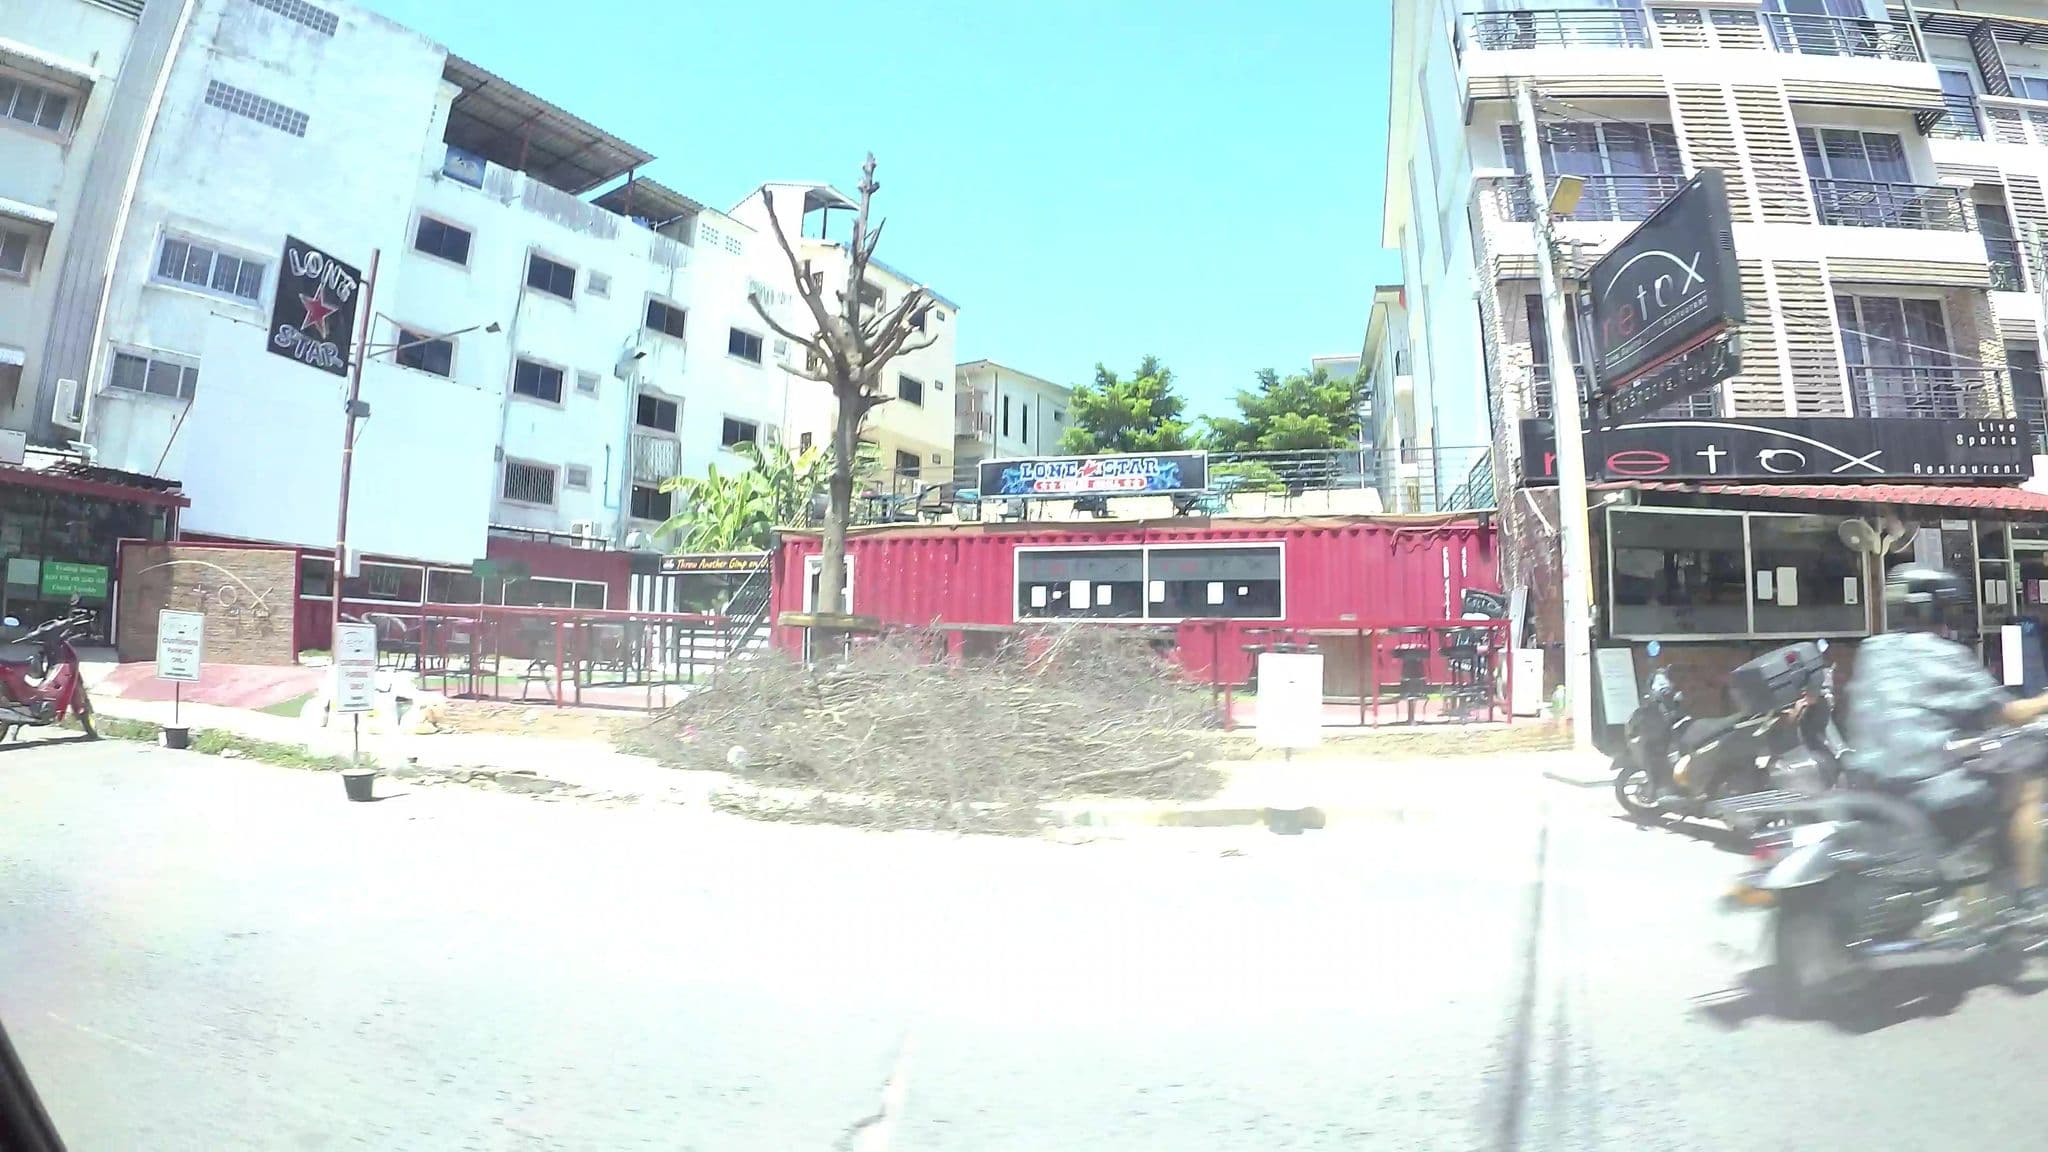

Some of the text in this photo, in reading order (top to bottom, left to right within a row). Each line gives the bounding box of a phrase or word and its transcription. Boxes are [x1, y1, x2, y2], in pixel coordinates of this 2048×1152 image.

[274, 324, 344, 368] STAR
[1979, 422, 2015, 432] Live
[1956, 434, 2017, 446] Sports
[1020, 459, 1159, 480] LONE STAR
[1913, 463, 2020, 474] Restaurant
[699, 558, 727, 569] Another
